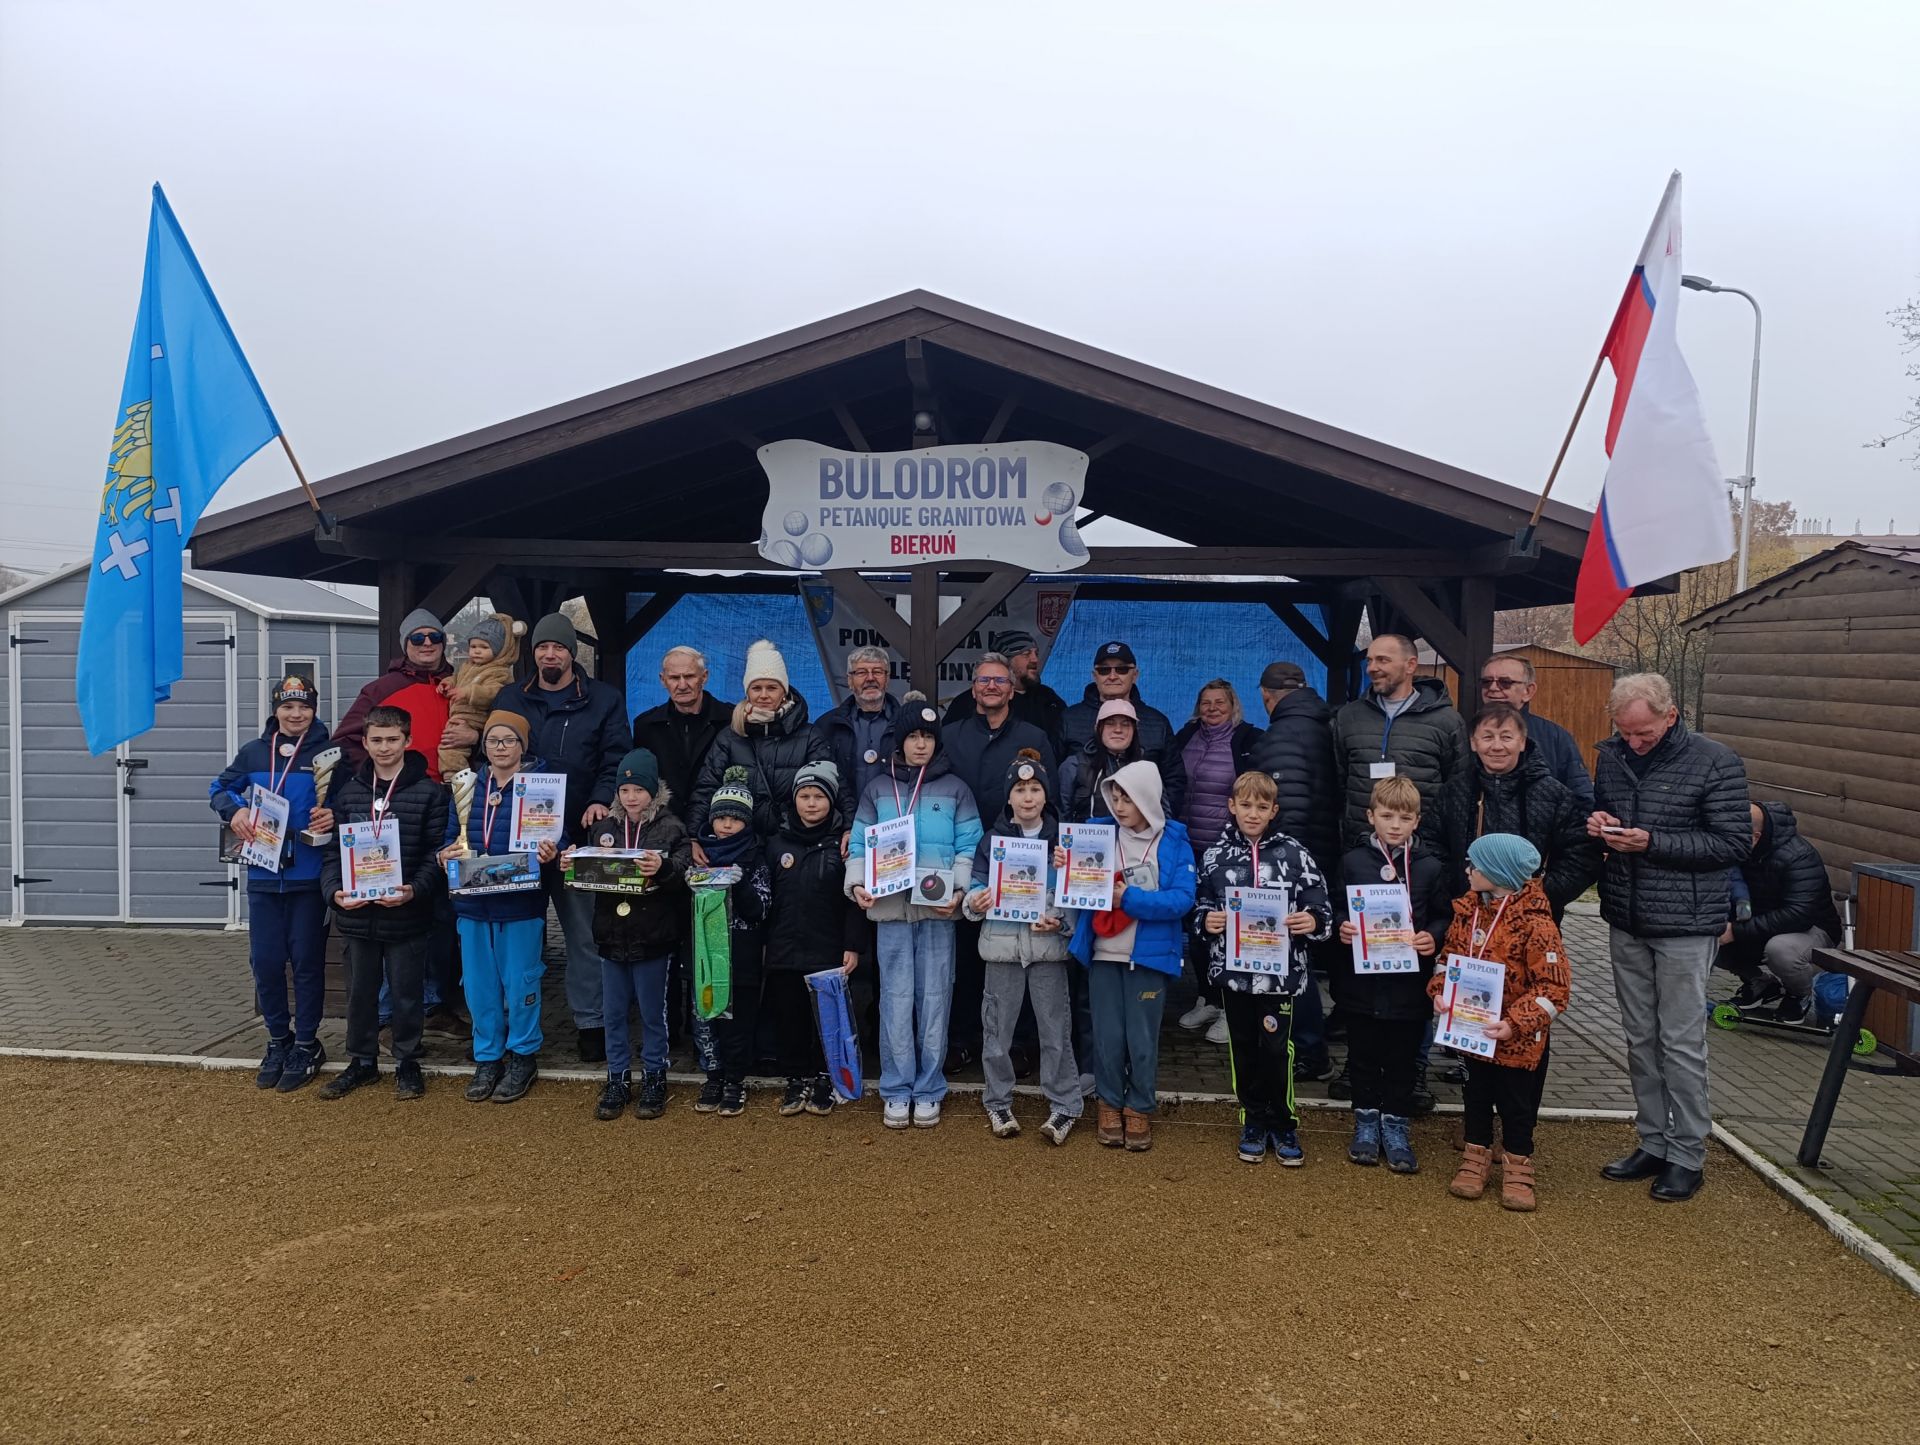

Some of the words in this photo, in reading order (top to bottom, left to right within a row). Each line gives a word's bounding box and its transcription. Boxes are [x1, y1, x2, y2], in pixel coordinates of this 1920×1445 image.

[819, 456, 1027, 500] BULODROM
[819, 507, 912, 529] PETANQUE
[918, 506, 1027, 527] GRANITOWA
[890, 530, 956, 555] BIERUŃ
[531, 777, 561, 785] DYPLOM
[882, 819, 909, 832] DYPLOM
[1078, 828, 1109, 836] DYPLOM
[1011, 842, 1042, 851] DYPLOM
[617, 884, 643, 892] CAR
[1370, 888, 1402, 896] DYPLOM
[1247, 892, 1281, 901] DYPLOM
[1467, 962, 1499, 975] DYPLOM
